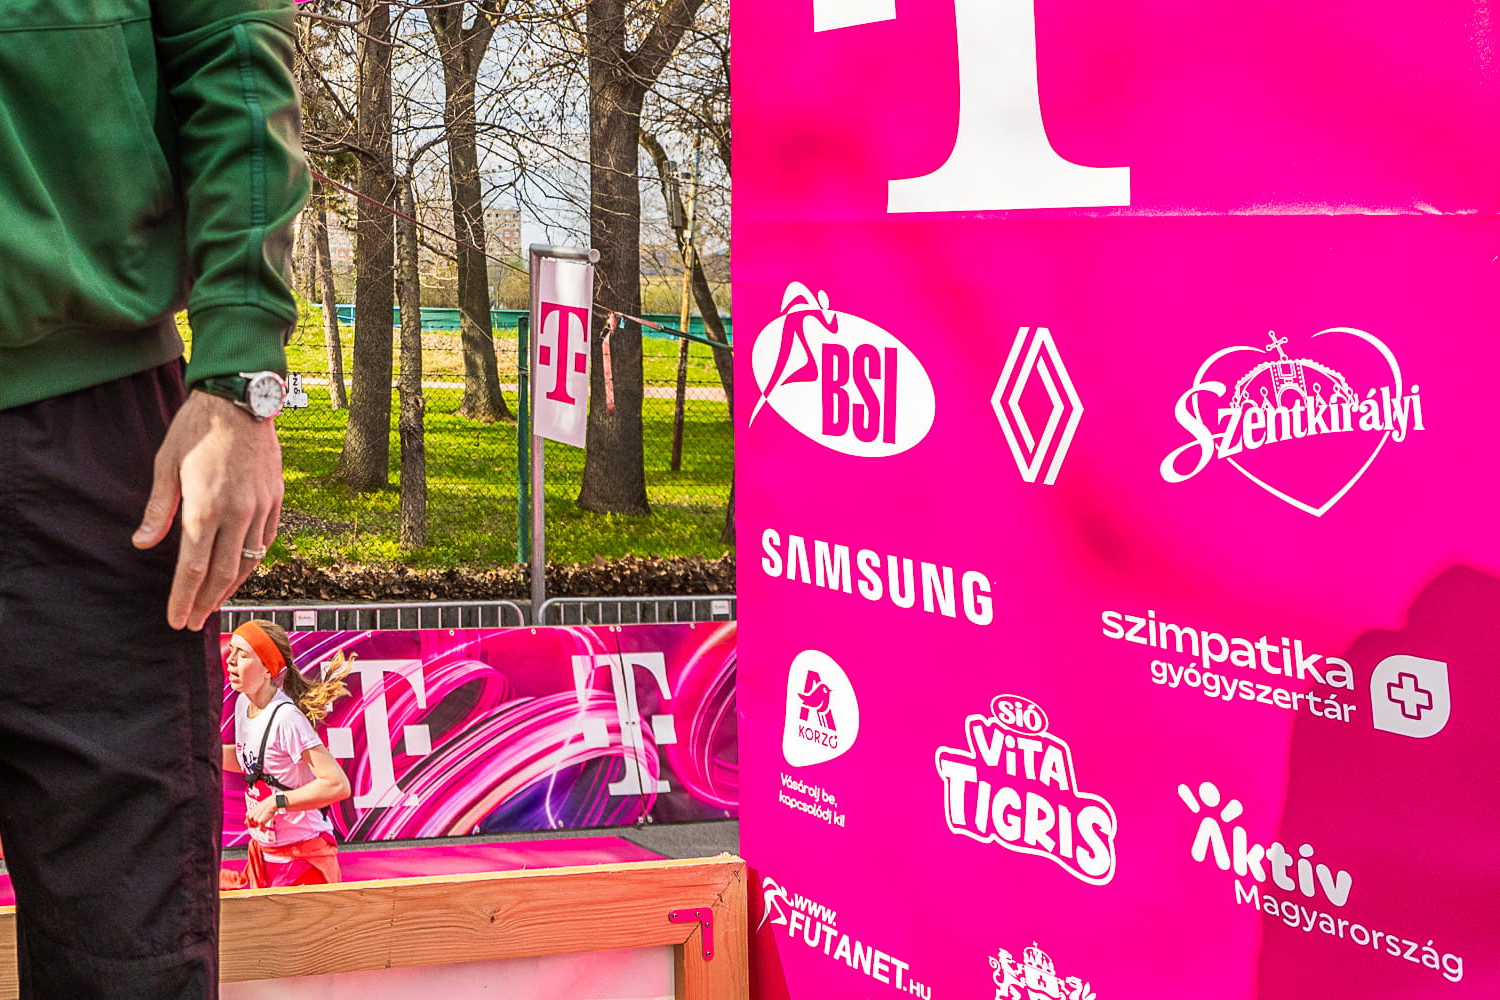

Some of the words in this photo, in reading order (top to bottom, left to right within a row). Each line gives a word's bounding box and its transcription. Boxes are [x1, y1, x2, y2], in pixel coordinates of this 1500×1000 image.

[539, 301, 589, 405] T
[821, 343, 898, 444] BSI
[1159, 384, 1426, 484] Szentkirályi
[761, 528, 994, 626] SAMSUNG
[1101, 609, 1355, 691] szimpatika
[1150, 659, 1357, 723] gyógyszertár
[572, 652, 678, 796] T
[778, 789, 832, 825] kapcsolódj
[780, 772, 821, 803] Vásárolj
[821, 788, 838, 808] be,
[941, 759, 1111, 876] TIGRIS
[788, 909, 932, 1000] FUTANET.HU
[1234, 879, 1464, 983] Magyarország
